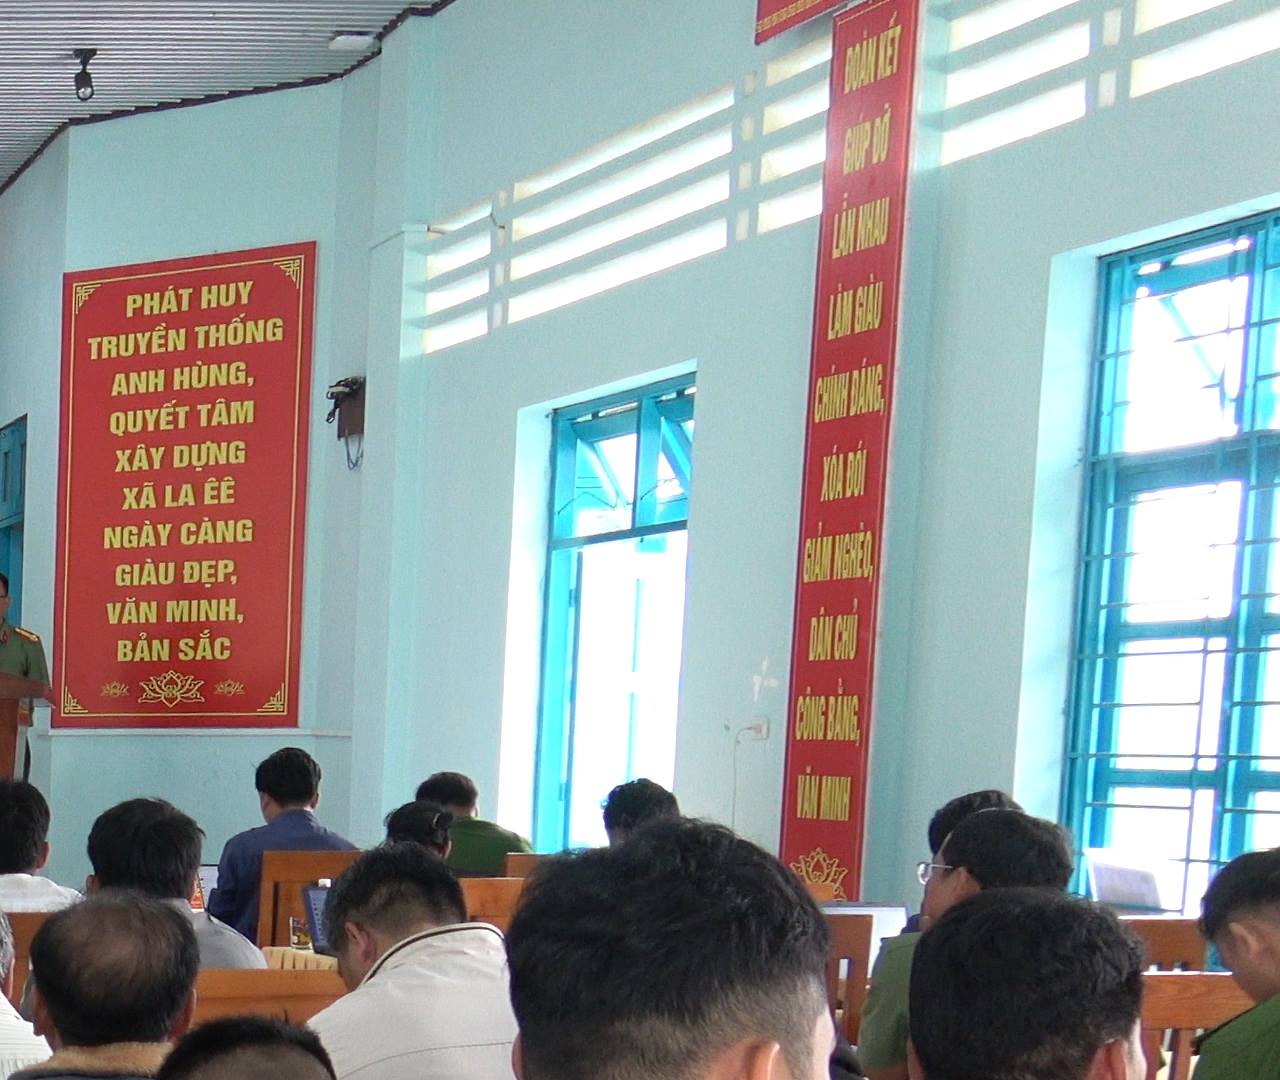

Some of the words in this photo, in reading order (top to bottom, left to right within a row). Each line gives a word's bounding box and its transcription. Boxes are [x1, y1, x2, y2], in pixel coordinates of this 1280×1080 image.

[844, 30, 876, 94] ĐOÀN
[877, 12, 901, 80] KẾT
[843, 122, 871, 175] GIÚP
[856, 197, 889, 251] NHAU
[127, 286, 192, 317] PHÁT
[201, 281, 253, 309] HUY
[828, 284, 853, 340] LÀM
[855, 274, 883, 333] GIÀU
[88, 323, 185, 359] TRUYỀN
[195, 313, 283, 348] THỐNG
[112, 370, 164, 396] ANH
[174, 361, 253, 390] HÙNG,
[815, 365, 847, 423] CHÍNH
[849, 356, 885, 416] ĐÁNG,
[110, 400, 189, 436] QUYẾT
[197, 400, 254, 426] TÂM
[115, 444, 164, 472] XÂY
[174, 441, 245, 471] DỰNG
[821, 445, 843, 501] XÓA
[846, 441, 866, 497] ĐÓI
[122, 482, 156, 509] XÃ
[165, 484, 195, 507] LA
[204, 477, 235, 504] ÊÊ
[104, 521, 172, 548] NGÀY
[181, 517, 252, 545] CÀNG
[803, 522, 832, 583] GIẢM
[834, 522, 874, 583] NGHÈO,
[116, 559, 174, 586] GIÀU
[183, 560, 237, 587] ĐẸP,
[107, 598, 157, 624] VĂN
[167, 598, 243, 623] MINH,
[809, 607, 833, 661] DÂN
[834, 598, 858, 660] CHỦ
[118, 632, 169, 661] BẢN
[180, 630, 230, 660] SẮC
[796, 687, 825, 740] CÔNG
[827, 678, 860, 746] BẰNG,
[797, 767, 819, 819] VĂN
[820, 776, 851, 821] MINH
